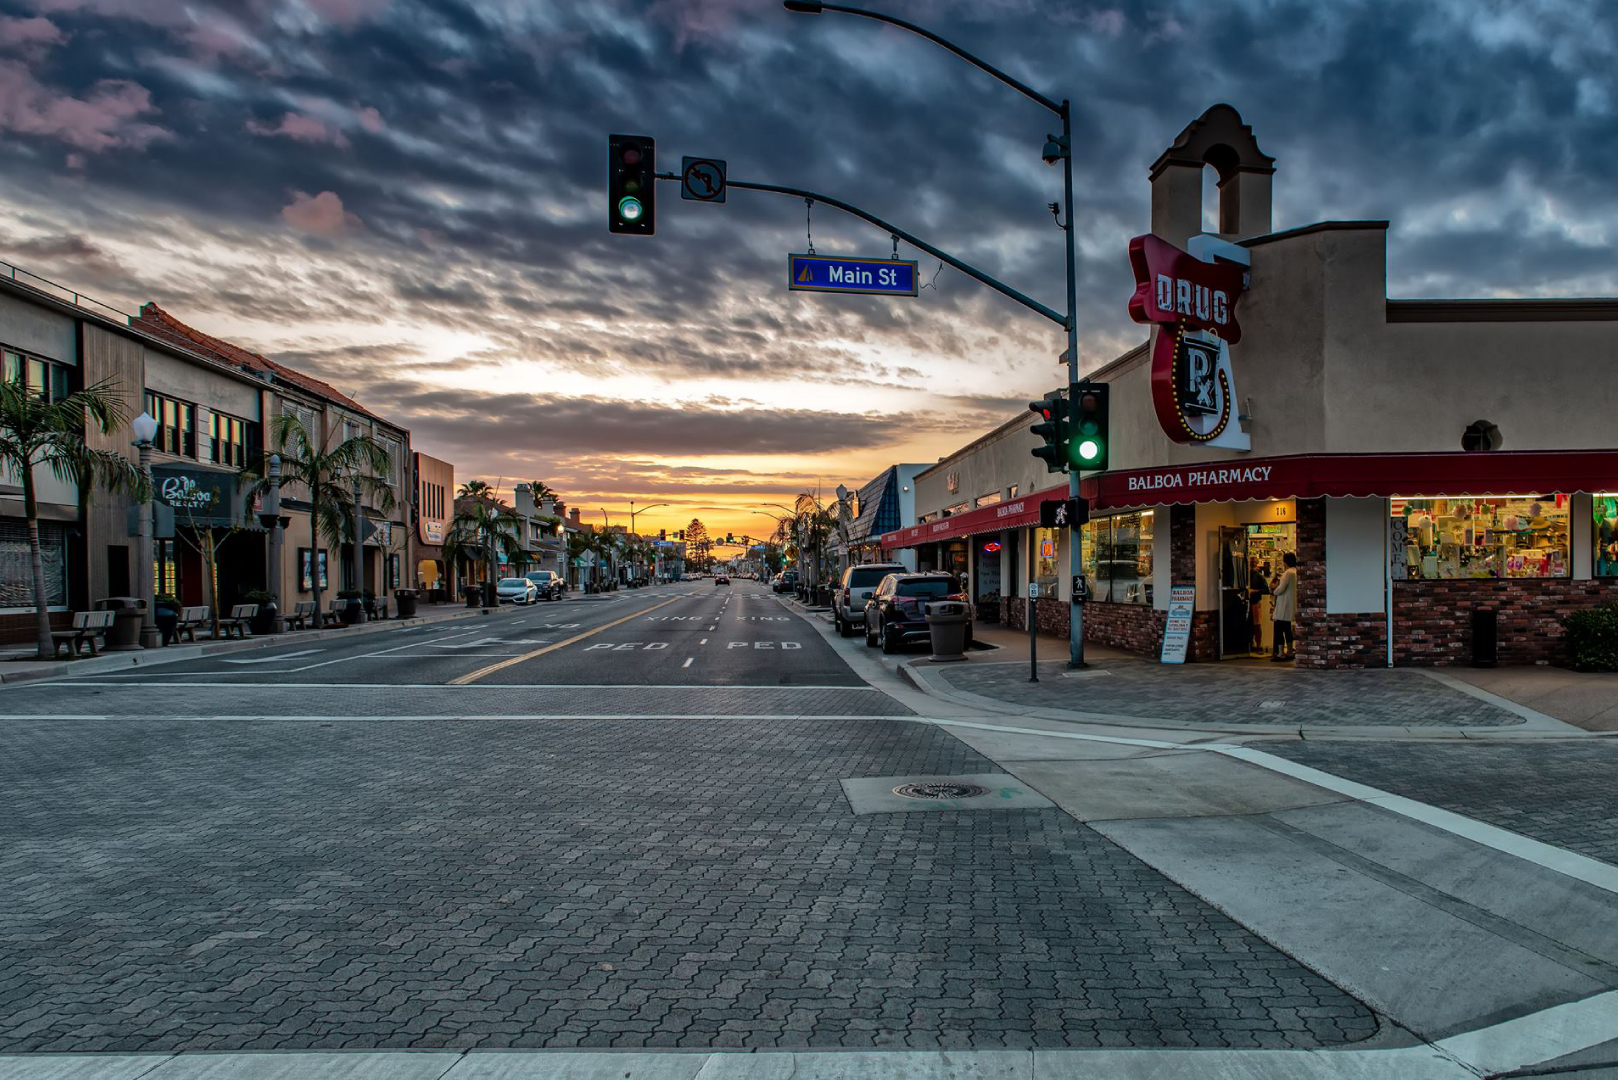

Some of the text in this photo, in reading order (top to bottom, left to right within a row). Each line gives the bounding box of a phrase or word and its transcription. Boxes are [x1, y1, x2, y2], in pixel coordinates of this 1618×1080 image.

[829, 265, 897, 286] Main St
[1157, 273, 1228, 325] DRUG
[1128, 466, 1272, 491] BALBOA PHARMACY
[583, 642, 670, 651] PED
[727, 641, 802, 649] PED
